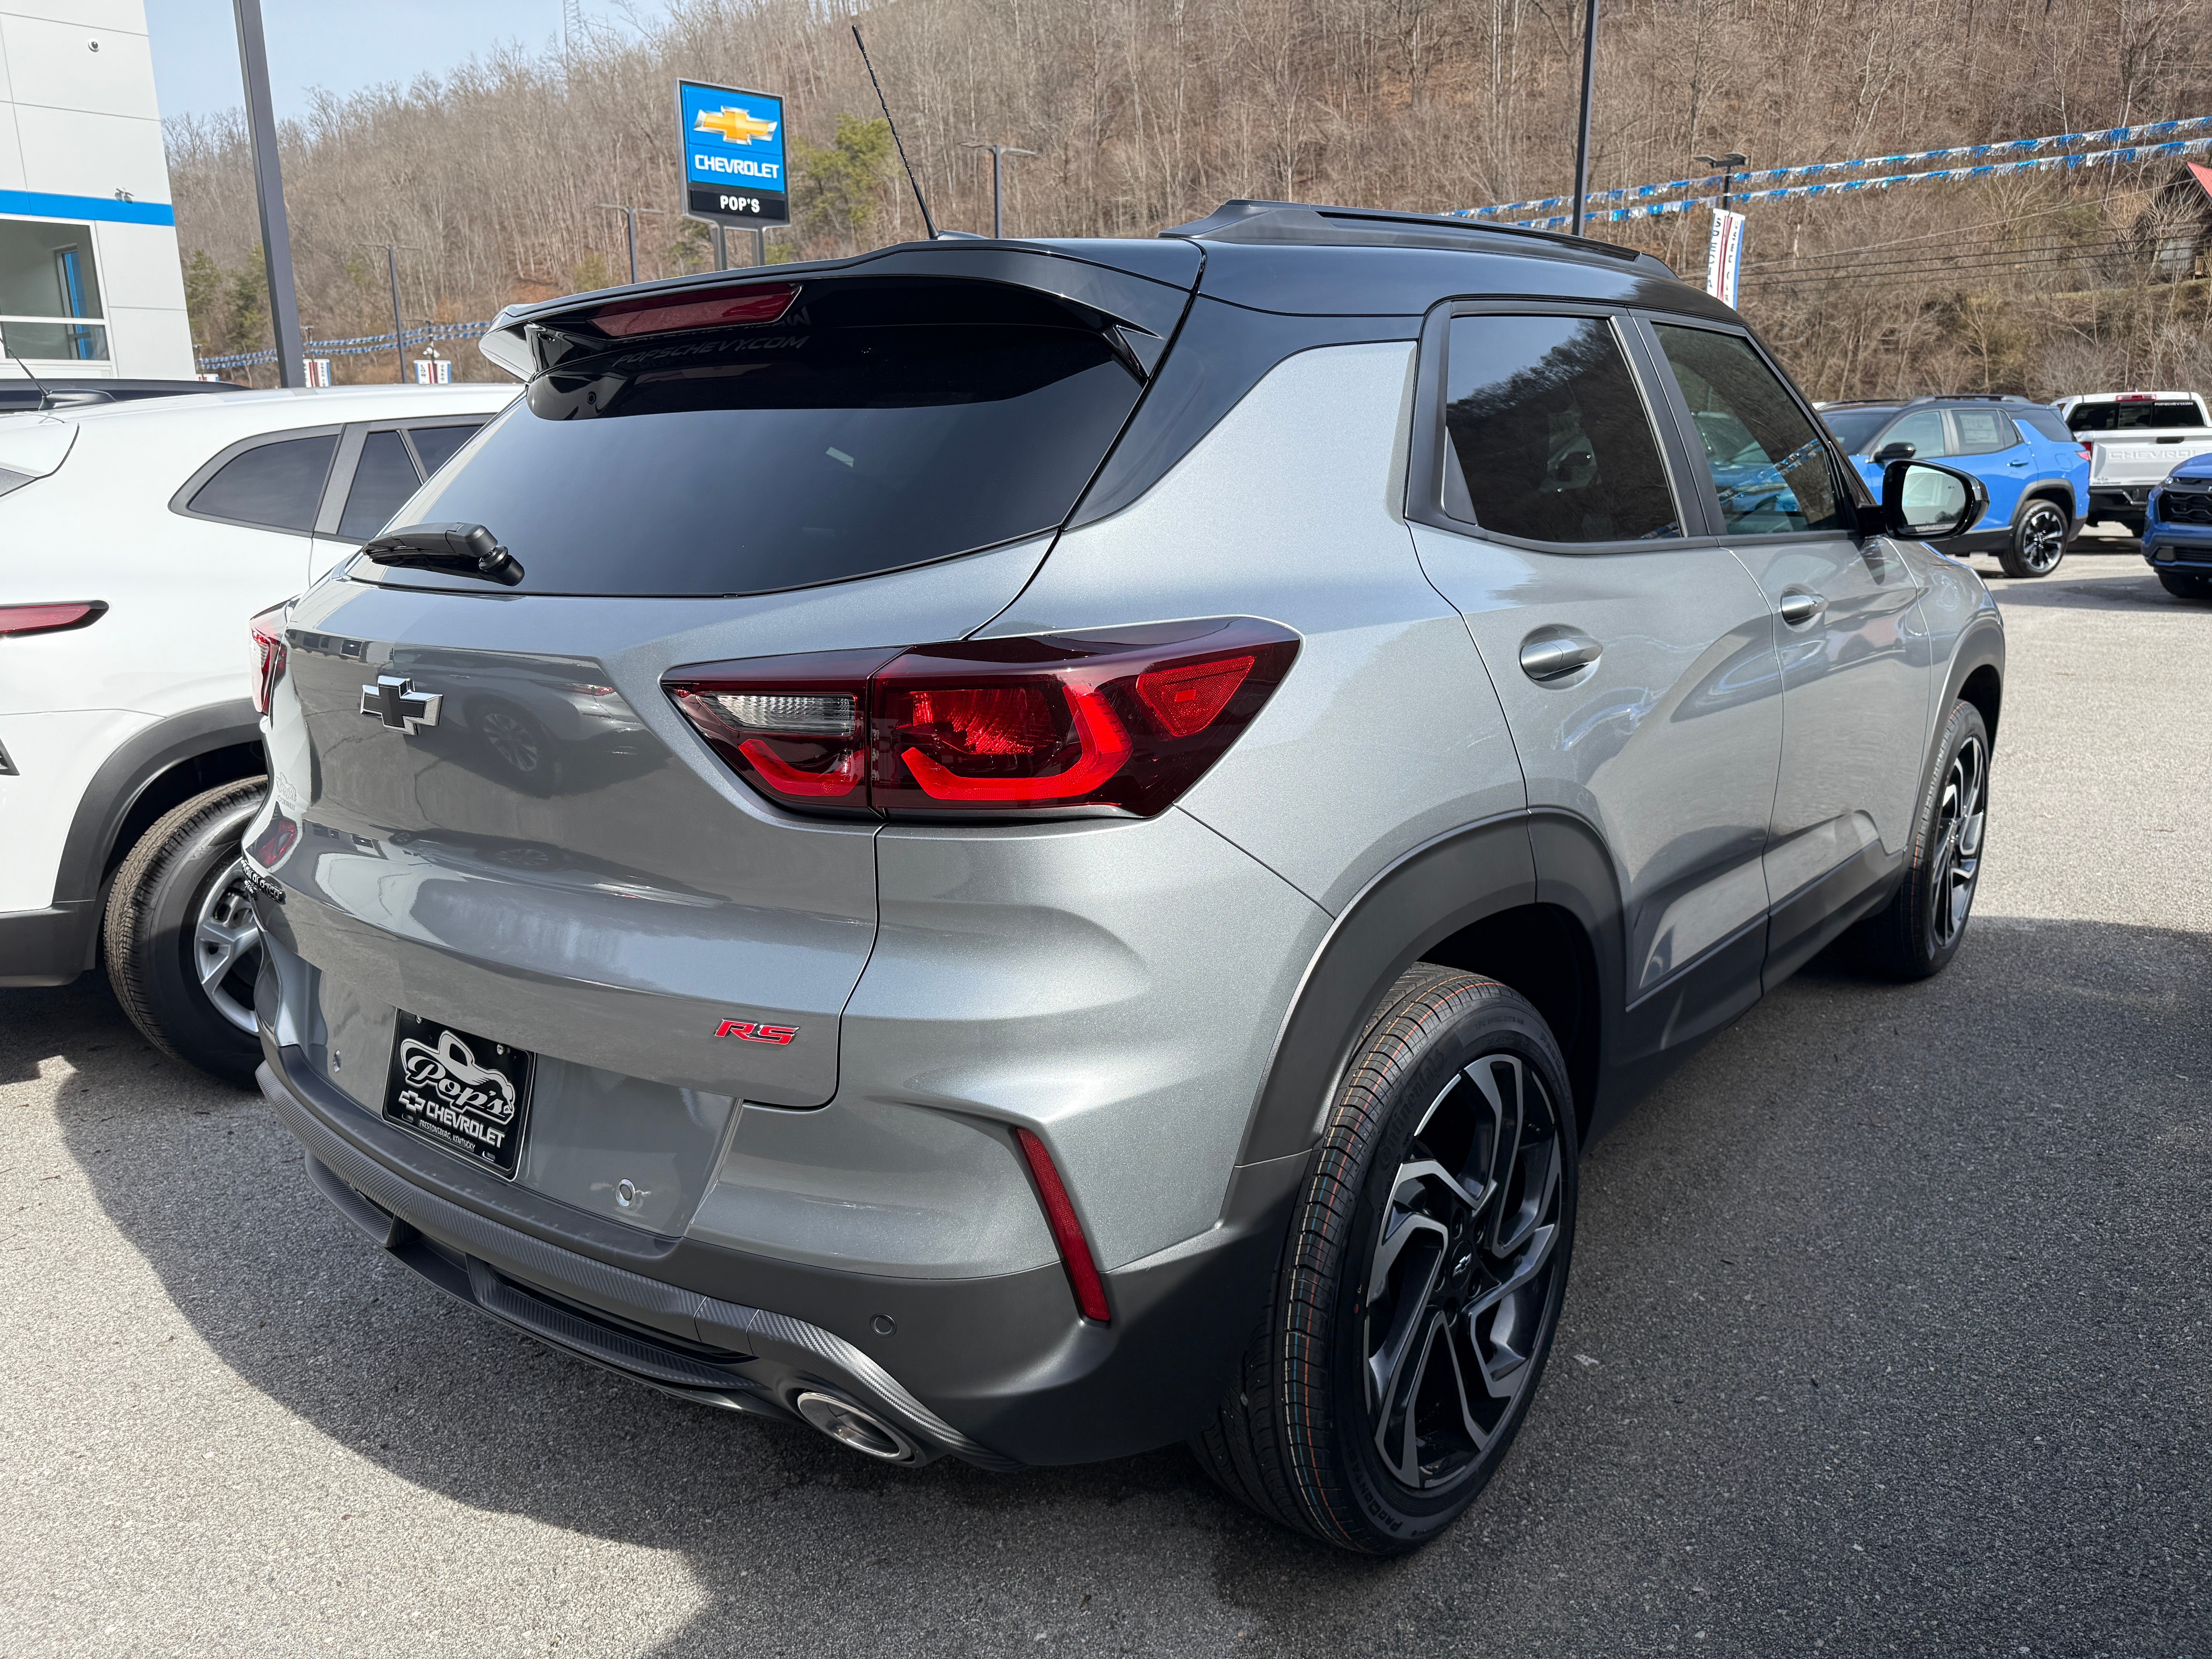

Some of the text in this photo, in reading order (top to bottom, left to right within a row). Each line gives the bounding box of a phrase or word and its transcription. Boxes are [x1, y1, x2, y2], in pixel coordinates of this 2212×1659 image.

[695, 154, 780, 179] CHEVROLET
[720, 194, 760, 213] POP'S
[612, 335, 811, 368] POPSCHEVY.COM
[2109, 450, 2212, 460] CHEVROL
[713, 1017, 800, 1045] RS
[407, 1055, 509, 1118] Pop's
[419, 1119, 476, 1151] PRESTONSBURG, KENTUCKY
[426, 1101, 505, 1149] CHEVROLET
